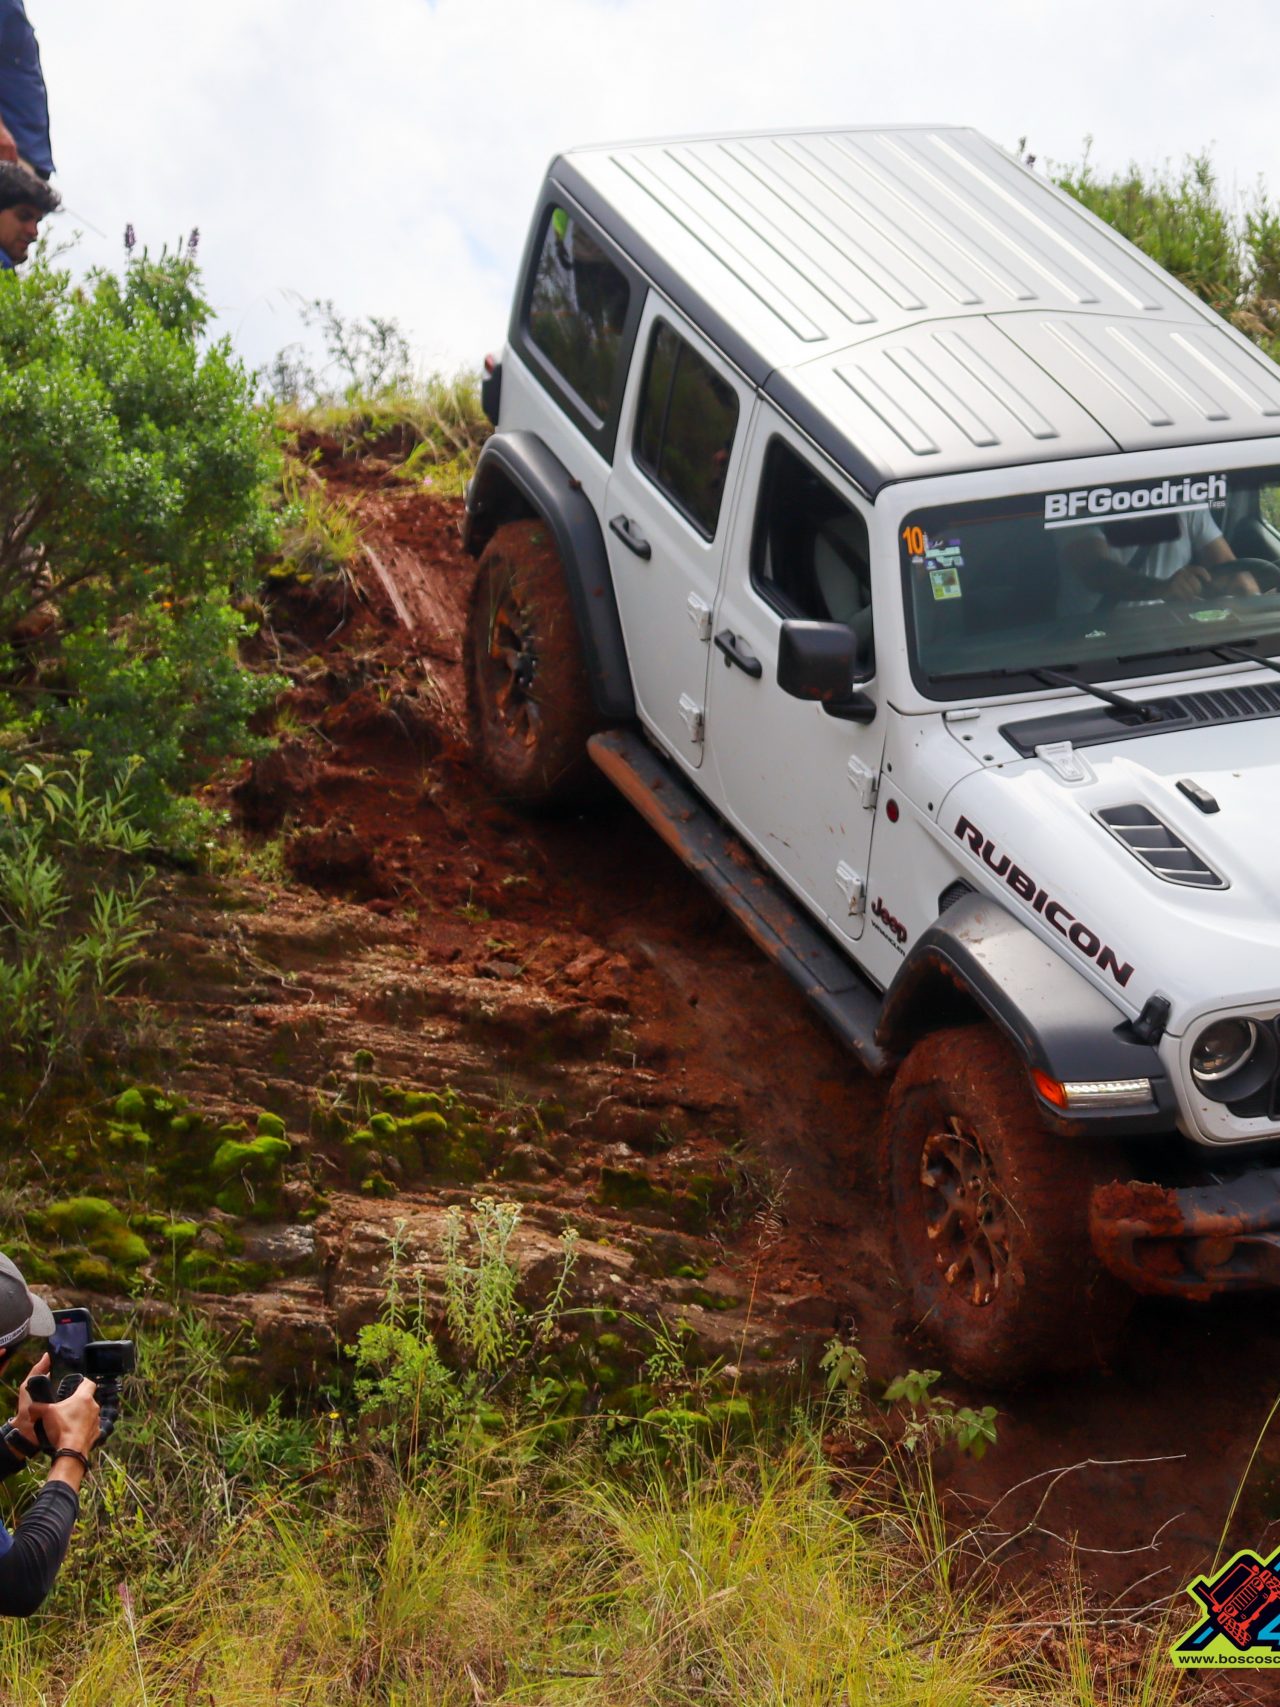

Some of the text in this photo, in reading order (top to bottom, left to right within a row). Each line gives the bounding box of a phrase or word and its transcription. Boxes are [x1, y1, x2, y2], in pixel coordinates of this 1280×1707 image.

[1044, 474, 1227, 520] BFGoodrich
[902, 526, 924, 556] 10
[871, 896, 907, 944] Jeep
[954, 815, 1135, 988] RUBICON
